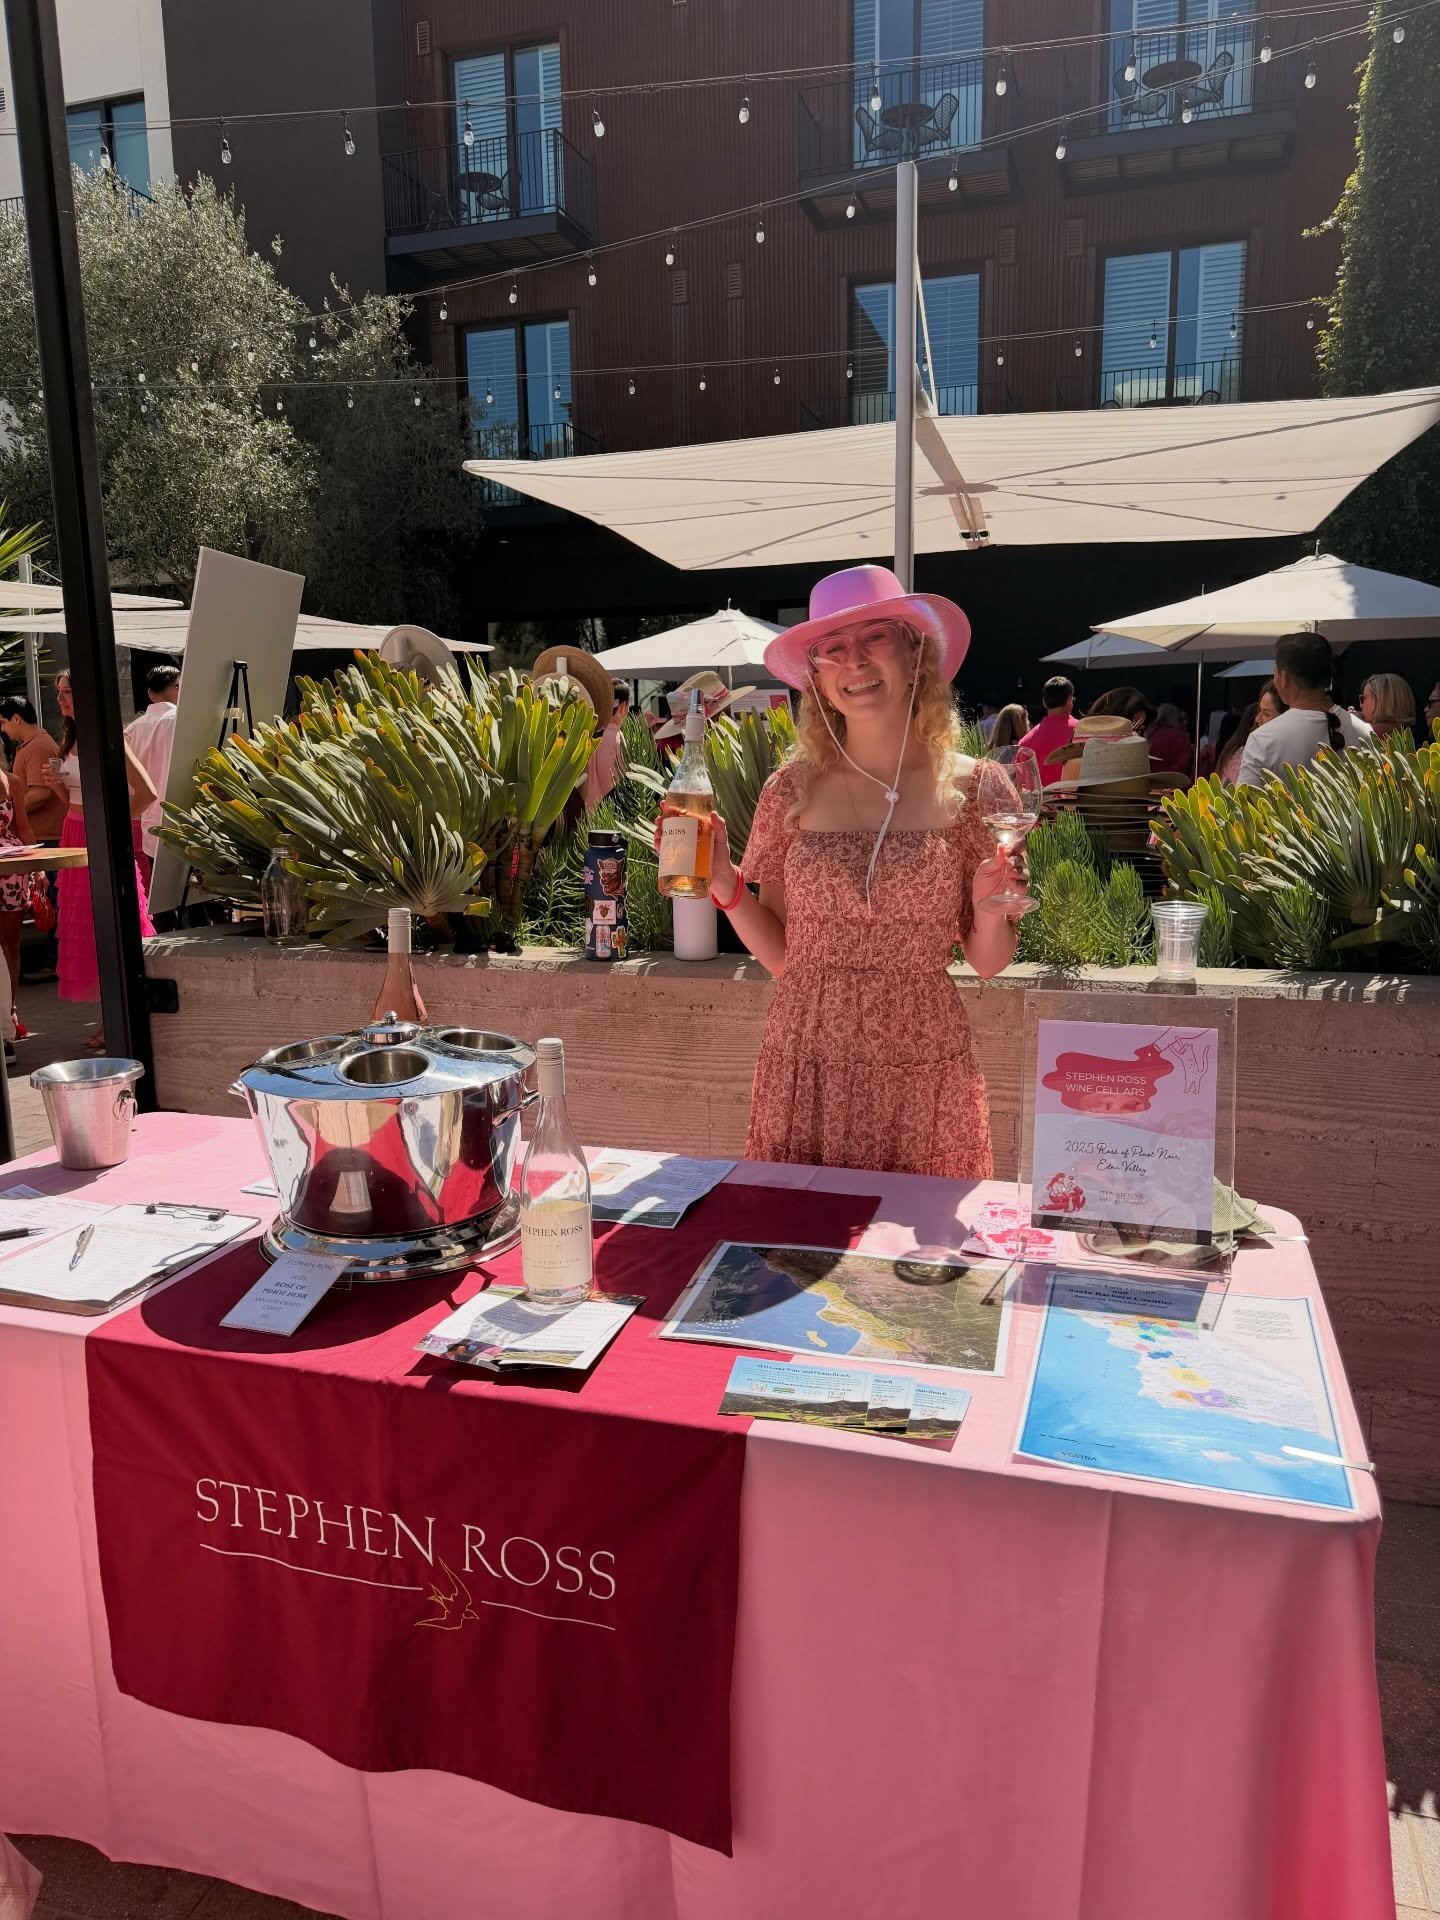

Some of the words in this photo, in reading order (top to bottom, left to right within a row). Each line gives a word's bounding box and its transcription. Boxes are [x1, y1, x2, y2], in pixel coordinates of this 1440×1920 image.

[669, 828, 686, 836] ROSS
[1065, 1071, 1115, 1083] STEPHEN
[1117, 1075, 1147, 1085] ROSS
[1065, 1083, 1094, 1093] WINE
[1095, 1085, 1145, 1097] CELLARS
[1064, 1140, 1094, 1154] 2025
[1120, 1148, 1129, 1158] of
[1131, 1145, 1155, 1158] Pinot
[1157, 1147, 1181, 1160] Noir
[1096, 1158, 1120, 1171] Edna
[1122, 1161, 1147, 1176] Valley
[522, 1224, 557, 1237] STEPHEN
[560, 1224, 583, 1236] ROSS
[897, 1264, 953, 1273] COAST
[262, 1288, 286, 1296] PINOT
[286, 1291, 308, 1299] NOIR
[1095, 1291, 1133, 1300] Barbara
[1134, 1296, 1173, 1305] Counties
[196, 1477, 437, 1567] STEPHEN
[462, 1522, 616, 1600] ROSS
